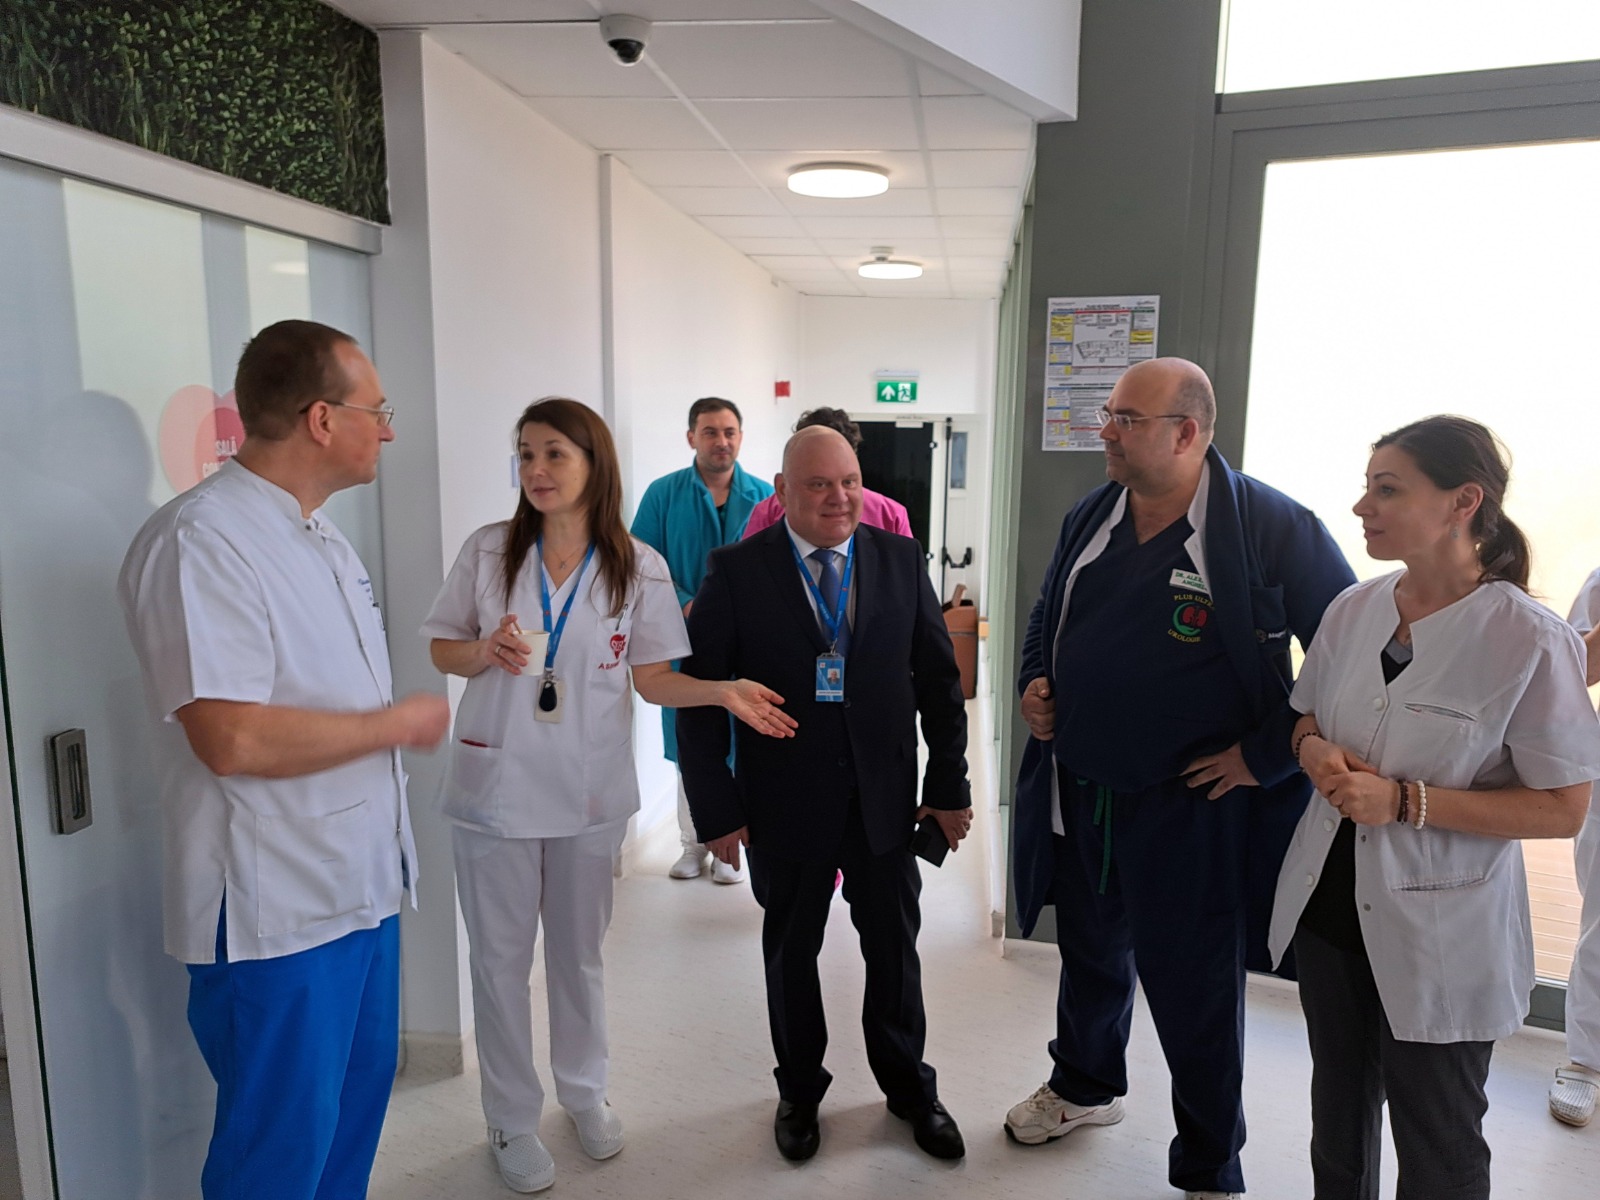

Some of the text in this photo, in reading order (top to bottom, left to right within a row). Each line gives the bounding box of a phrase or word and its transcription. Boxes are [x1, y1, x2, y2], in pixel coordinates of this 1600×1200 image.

[1173, 593, 1214, 609] PLUS ULTR
[1167, 629, 1201, 643] UROLOGIE
